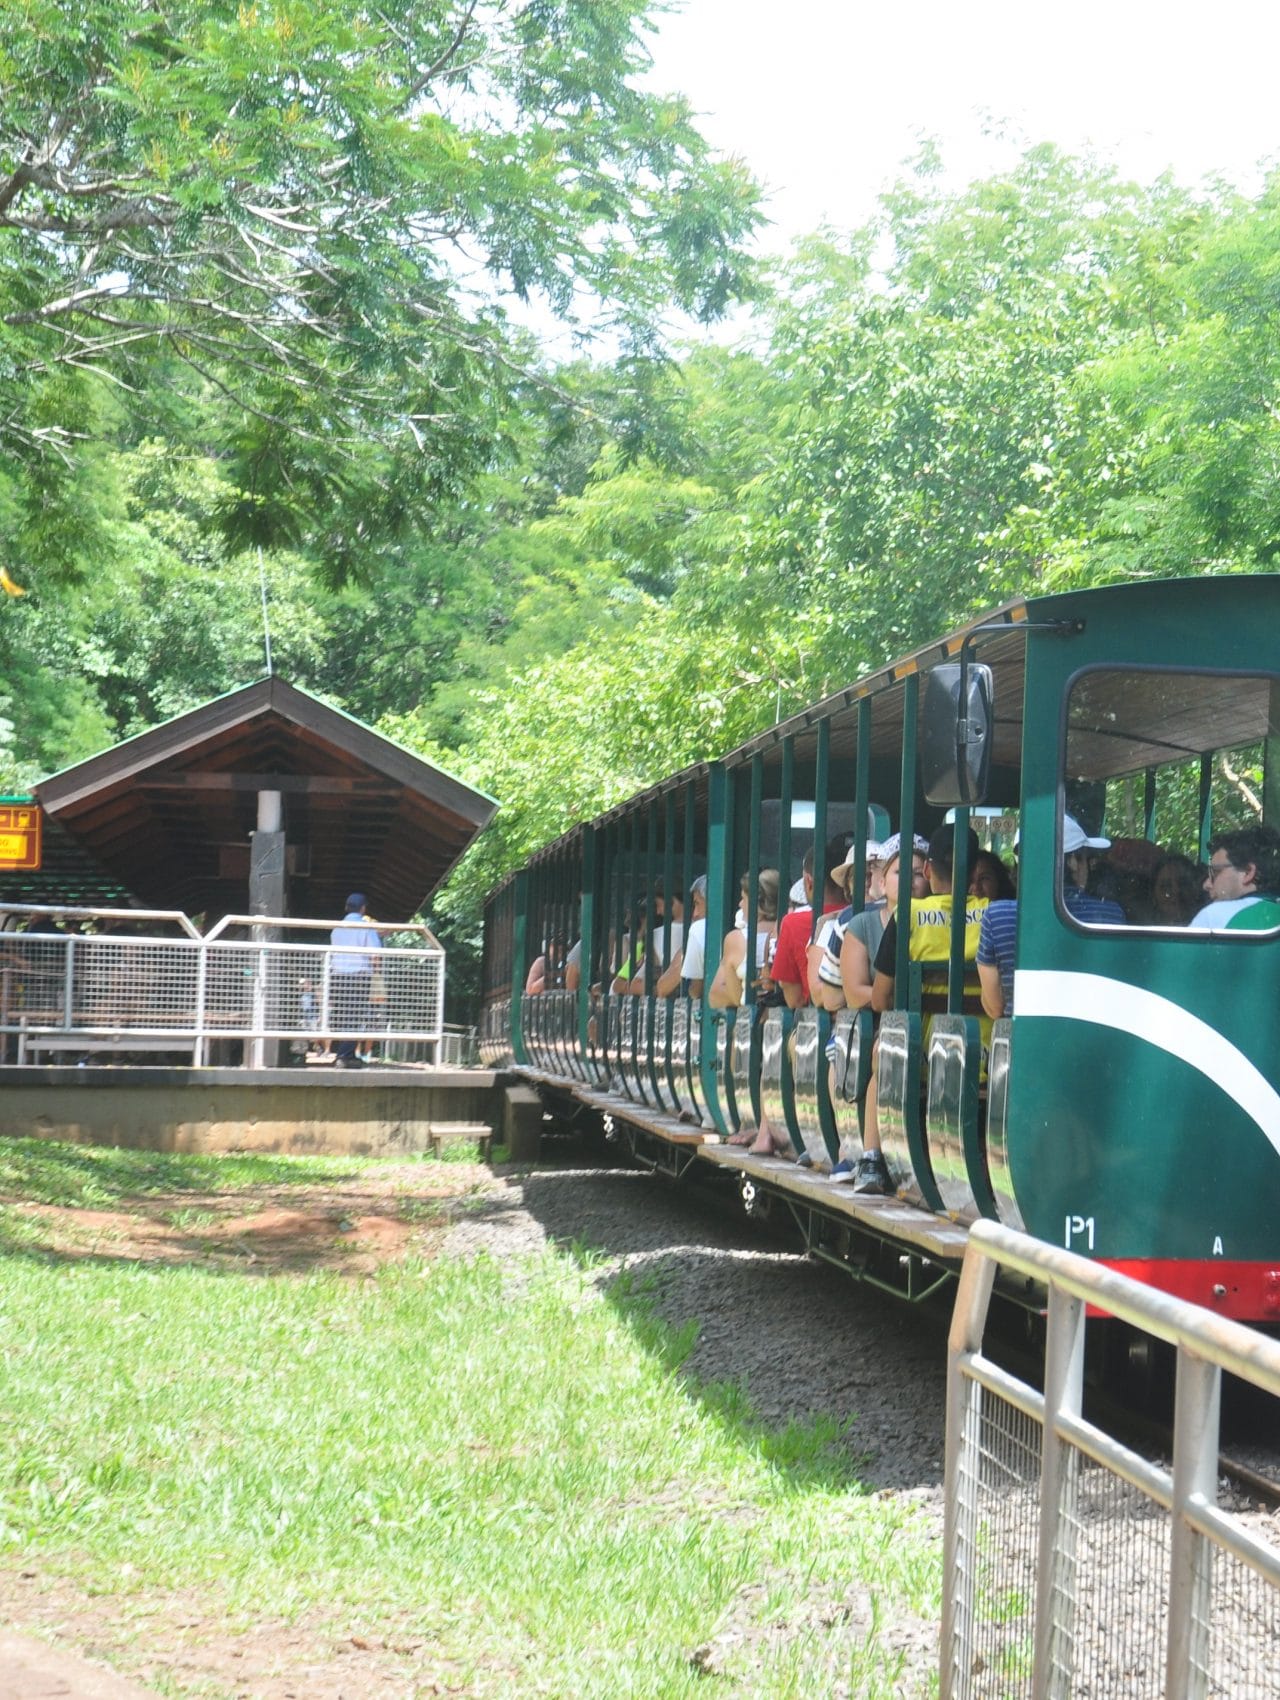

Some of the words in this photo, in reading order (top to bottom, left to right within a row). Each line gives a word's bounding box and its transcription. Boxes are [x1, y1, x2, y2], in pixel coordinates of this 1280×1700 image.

[917, 910, 946, 927] DON
[1065, 1215, 1095, 1250] P1
[1212, 1236, 1224, 1256] A
